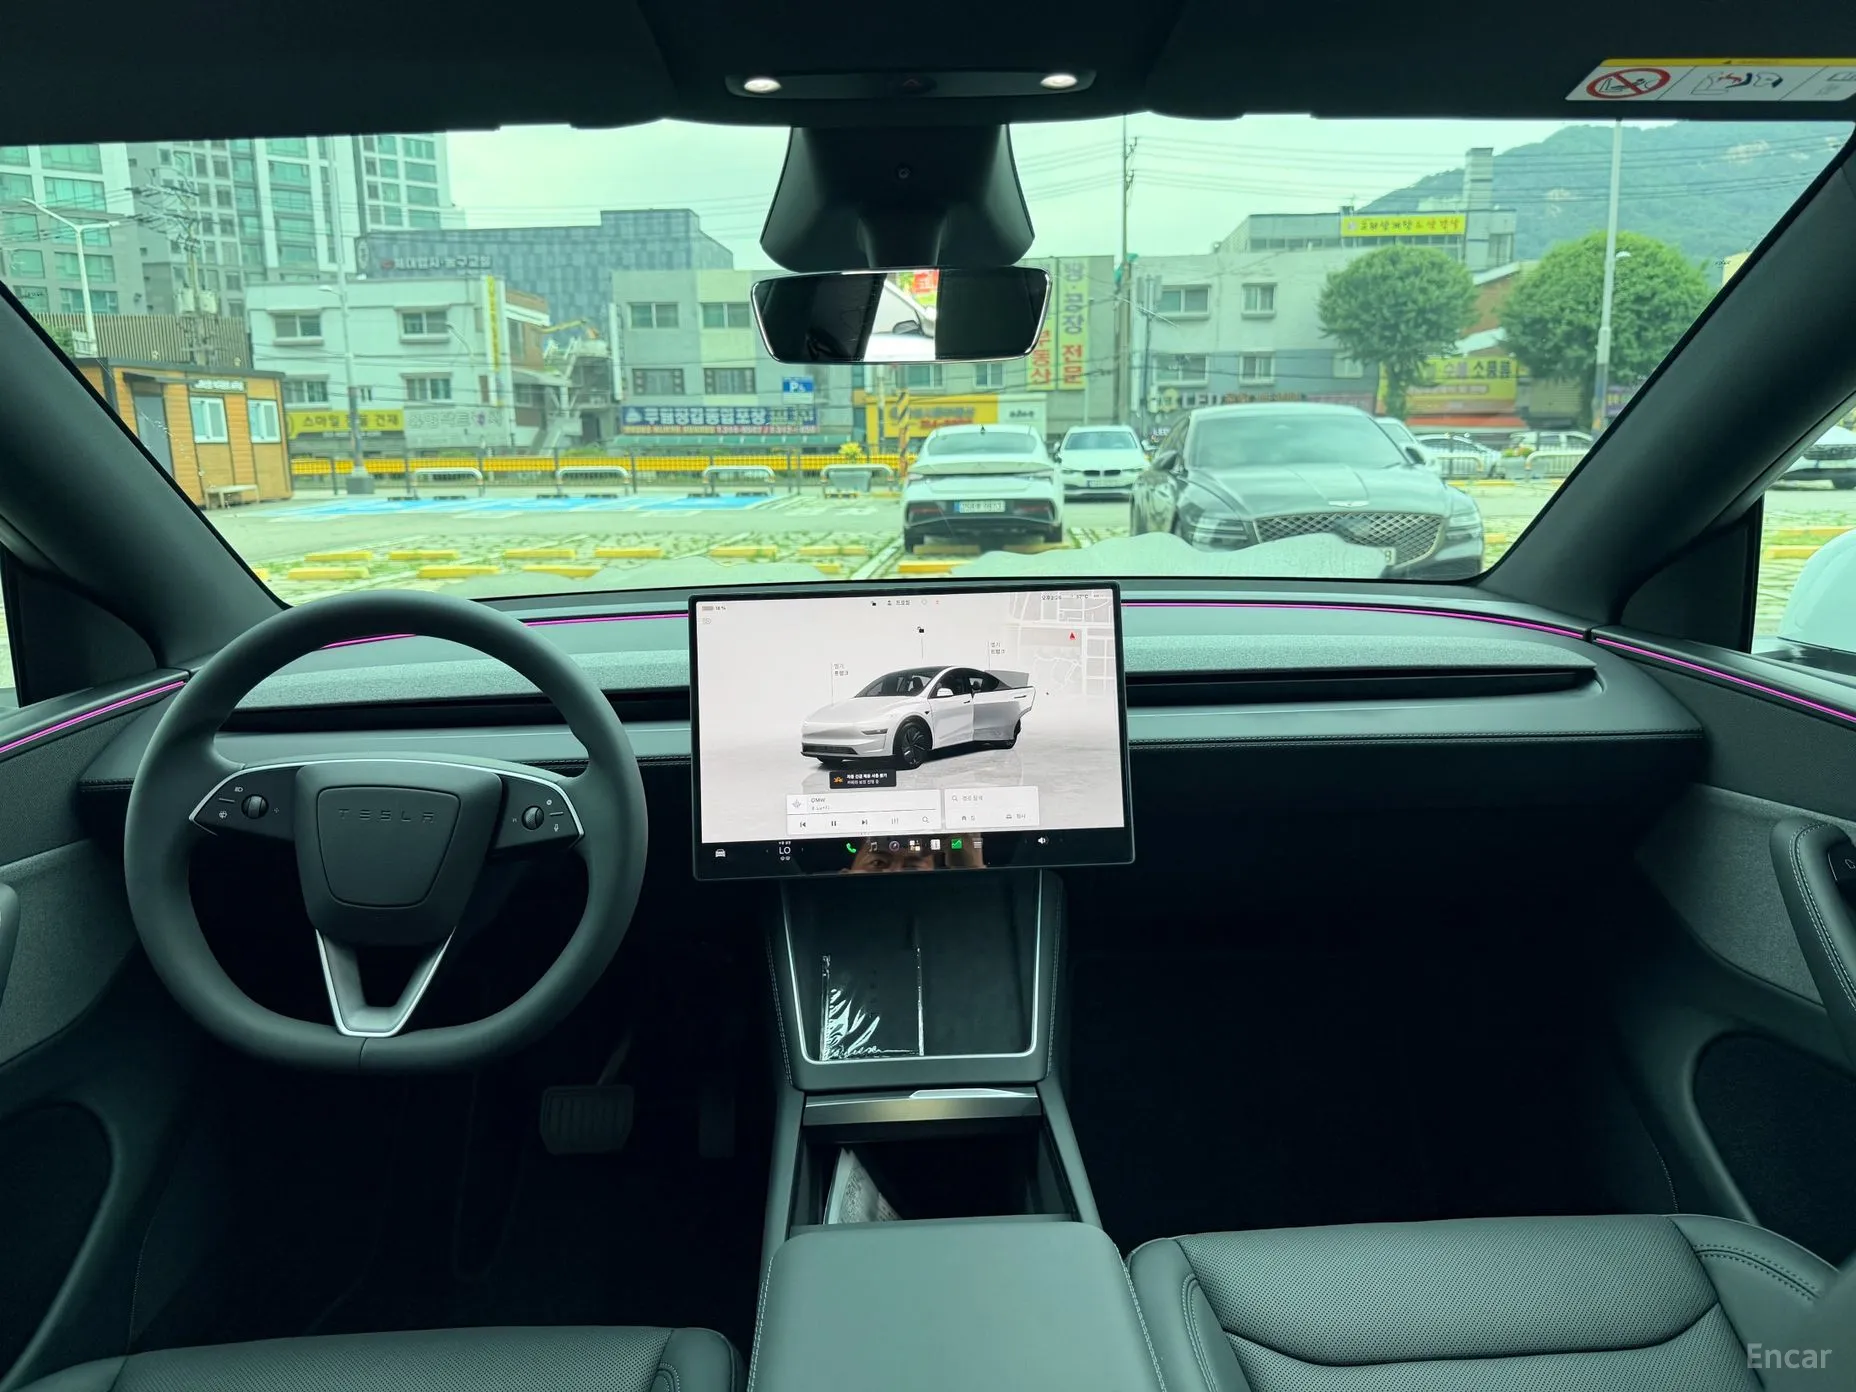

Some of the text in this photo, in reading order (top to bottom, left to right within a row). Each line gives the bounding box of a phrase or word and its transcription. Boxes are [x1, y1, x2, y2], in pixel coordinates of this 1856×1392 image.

[1063, 344, 1084, 384] 전문
[376, 413, 399, 426] 건재
[338, 808, 435, 824] TESLA
[779, 846, 791, 855] LO
